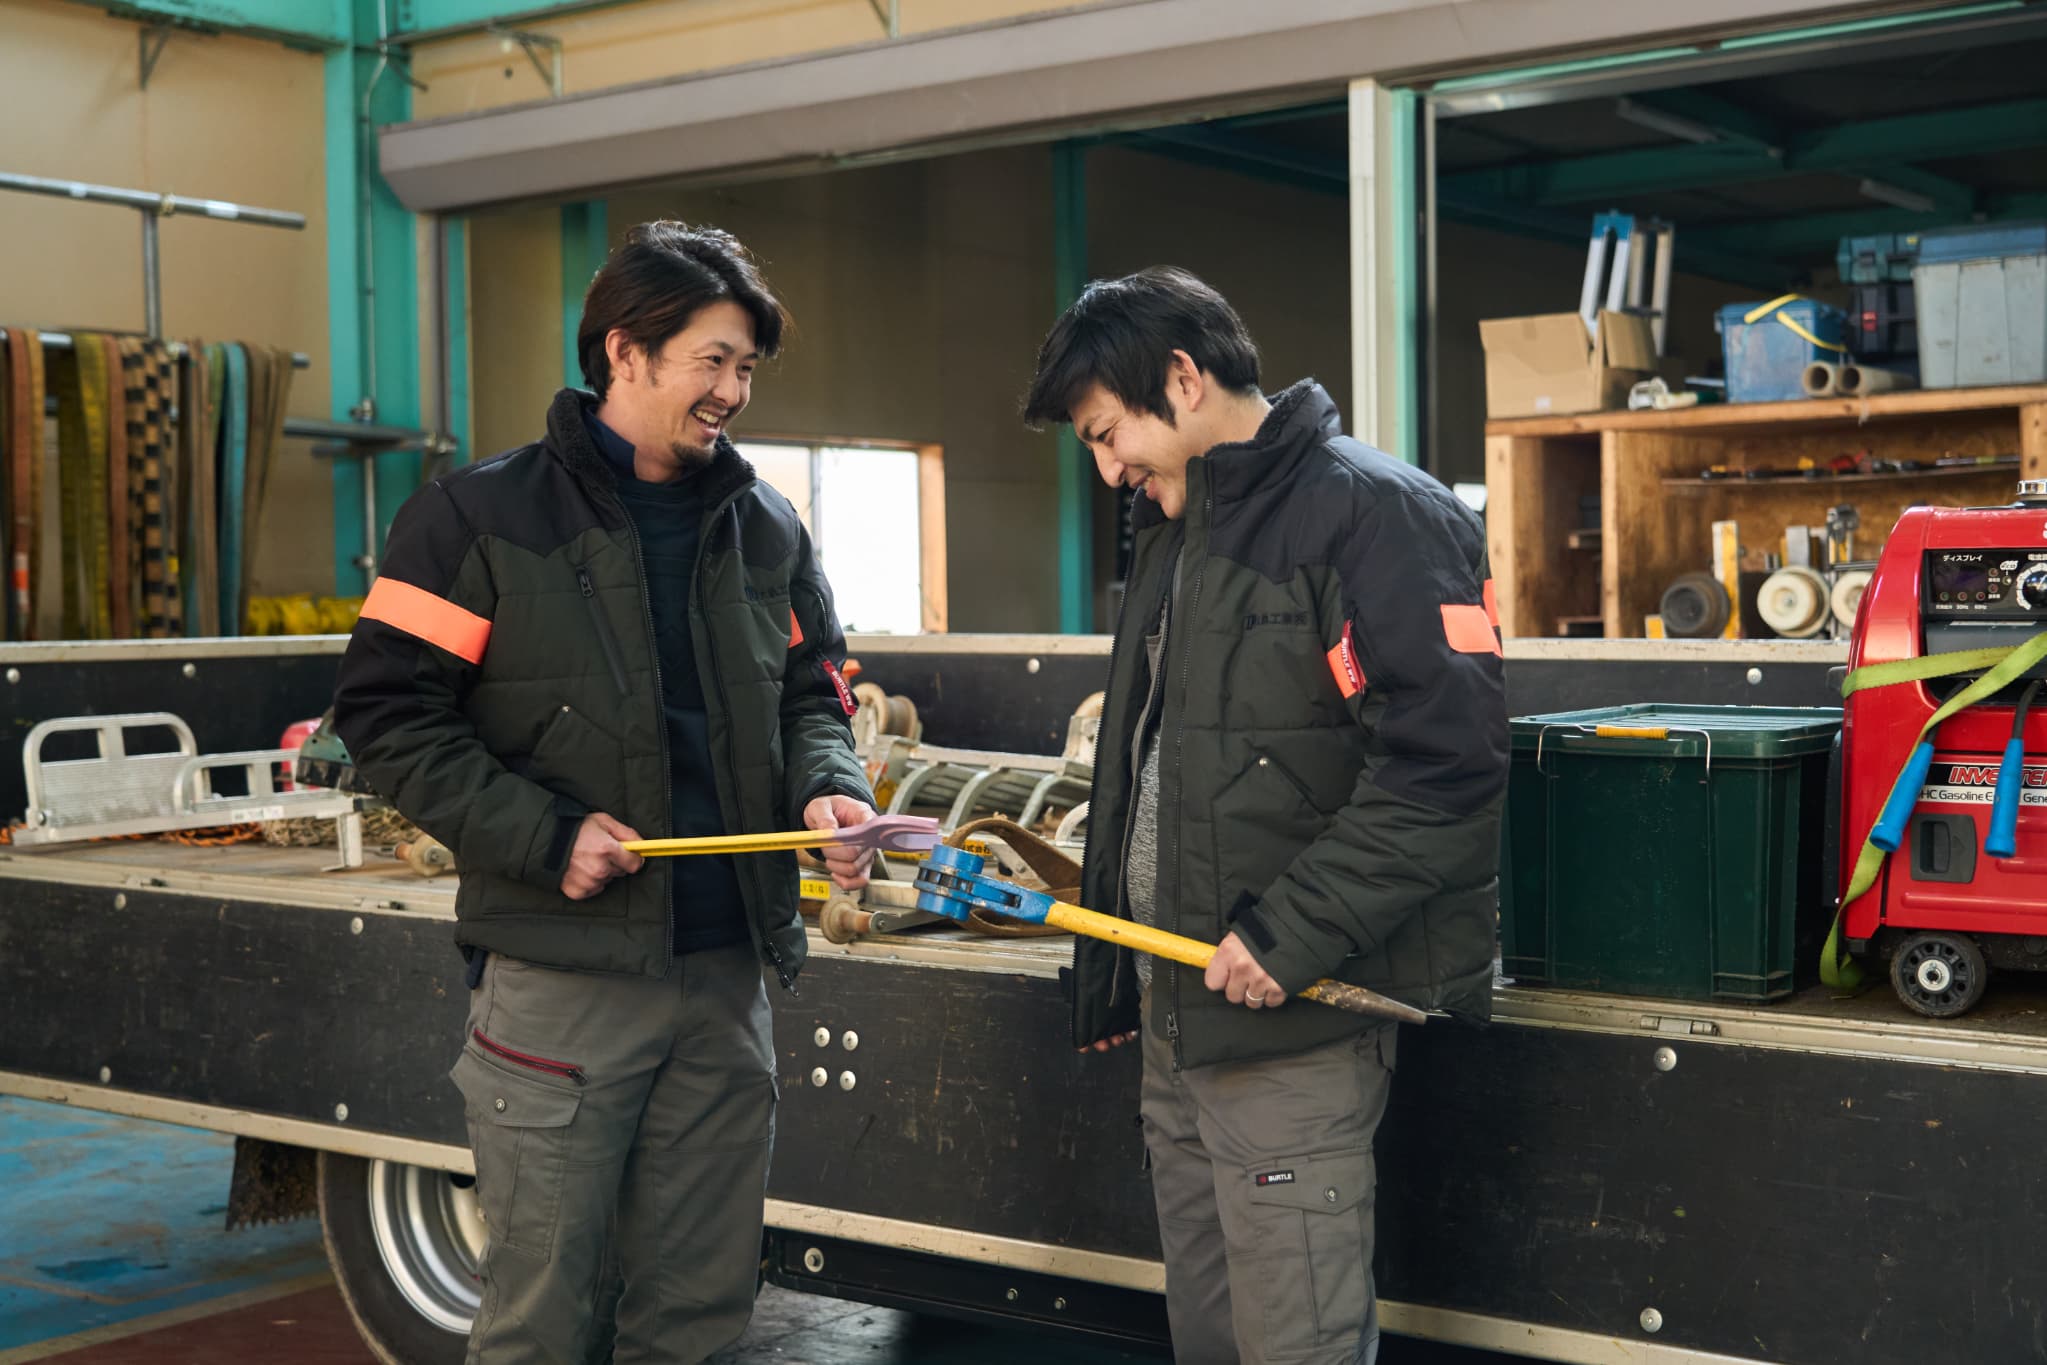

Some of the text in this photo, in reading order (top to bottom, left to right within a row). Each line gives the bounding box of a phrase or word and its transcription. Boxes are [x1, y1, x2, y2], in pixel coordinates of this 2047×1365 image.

[1943, 554, 1983, 562] ディスプレイ
[1920, 789, 1937, 800] HC
[1938, 790, 1984, 802] Gasoline
[1268, 1173, 1292, 1182] BURTLE
